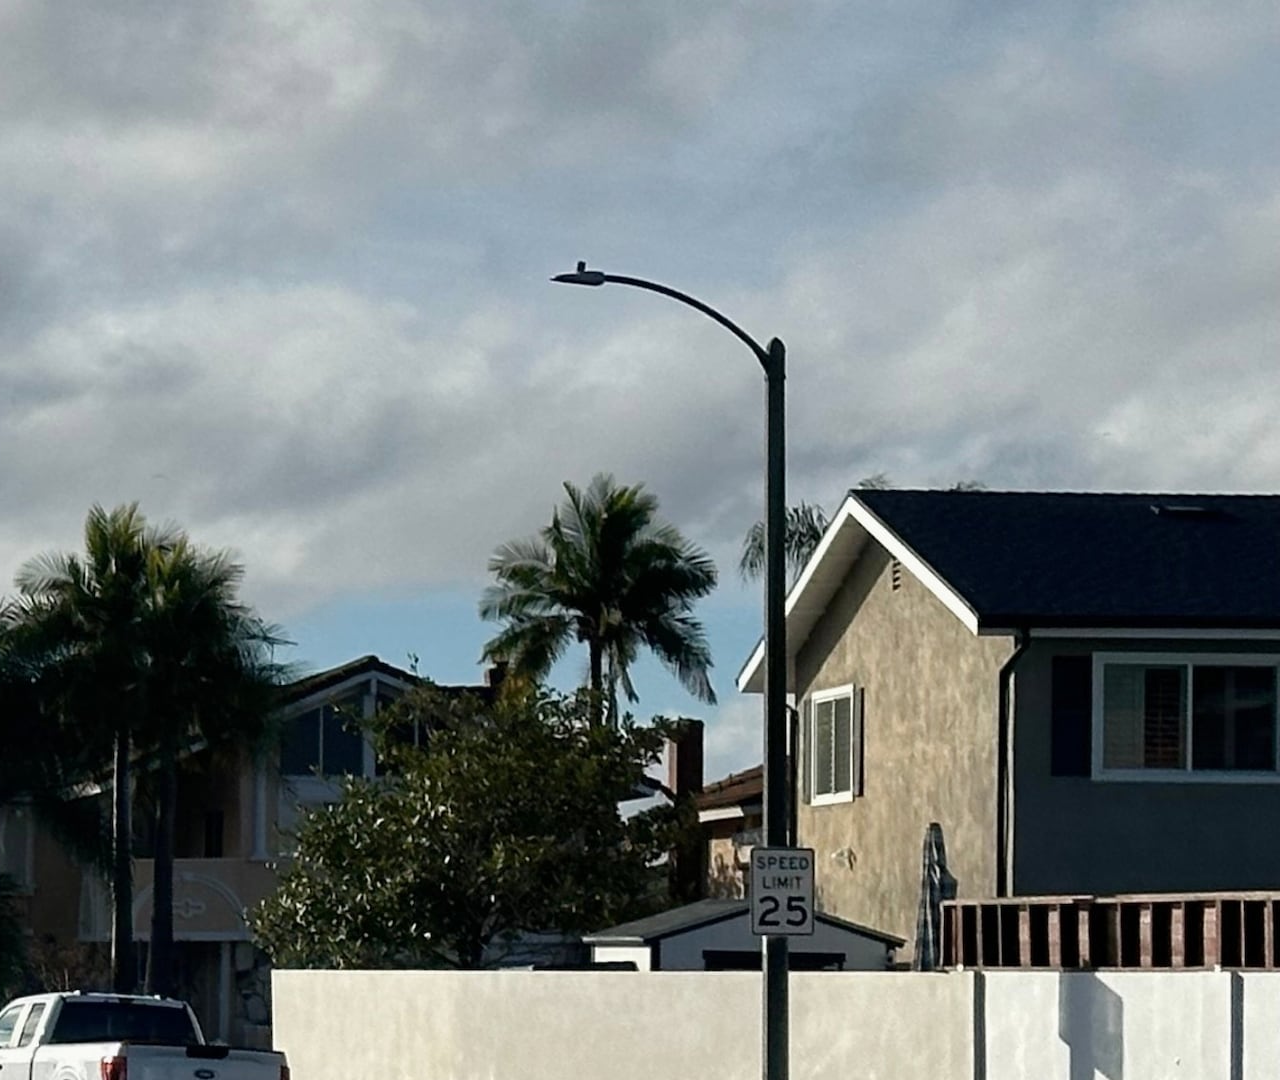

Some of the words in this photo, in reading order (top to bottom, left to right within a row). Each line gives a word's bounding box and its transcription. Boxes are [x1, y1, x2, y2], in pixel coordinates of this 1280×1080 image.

[756, 856, 809, 870] SPEED
[762, 876, 801, 889] LIMIT
[758, 895, 808, 926] 25
